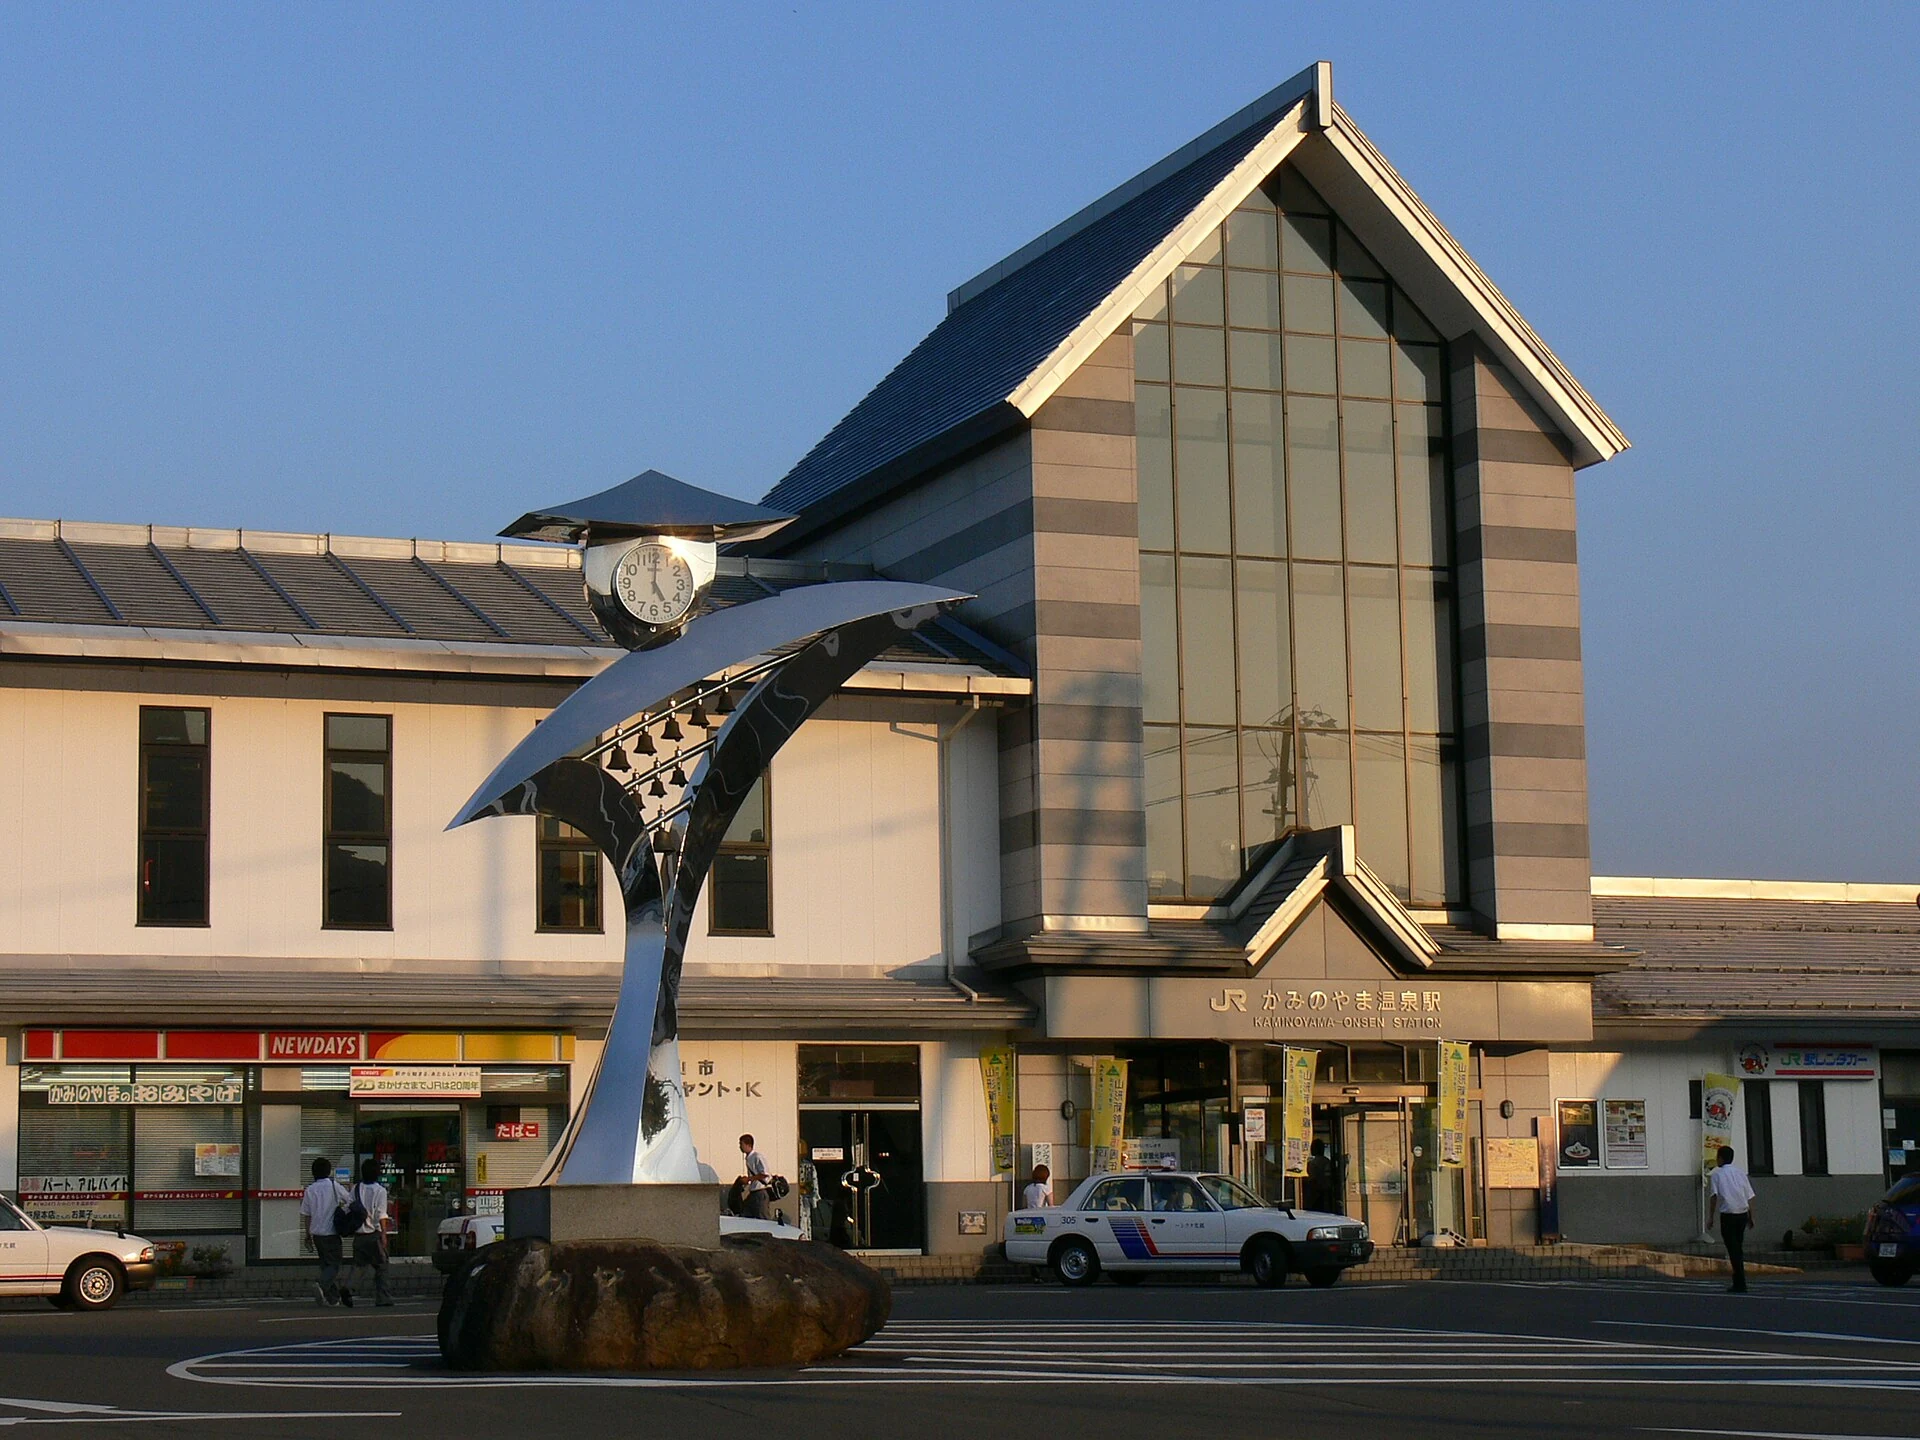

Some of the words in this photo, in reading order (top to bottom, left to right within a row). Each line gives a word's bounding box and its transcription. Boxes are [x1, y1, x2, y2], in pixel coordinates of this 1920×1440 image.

[636, 552, 646, 566] 11
[626, 564, 638, 576] 10
[672, 565, 681, 577] 2
[622, 577, 631, 589] 9
[676, 579, 685, 591] 3
[627, 589, 636, 601] 8
[672, 592, 681, 604] 4
[637, 601, 646, 612] 7
[650, 604, 659, 616] 6
[663, 602, 672, 613] 5
[1210, 988, 1247, 1012] JR
[1262, 989, 1441, 1012] かみのやま温泉駅
[1393, 1016, 1442, 1029] STATION
[272, 1036, 356, 1055] NEWDAYS
[378, 1081, 479, 1091] おかげさまでJRは20周年
[50, 1084, 240, 1102] かみのやまのおみやげ
[497, 1123, 538, 1138] たばこ
[1061, 1216, 1076, 1225] 305
